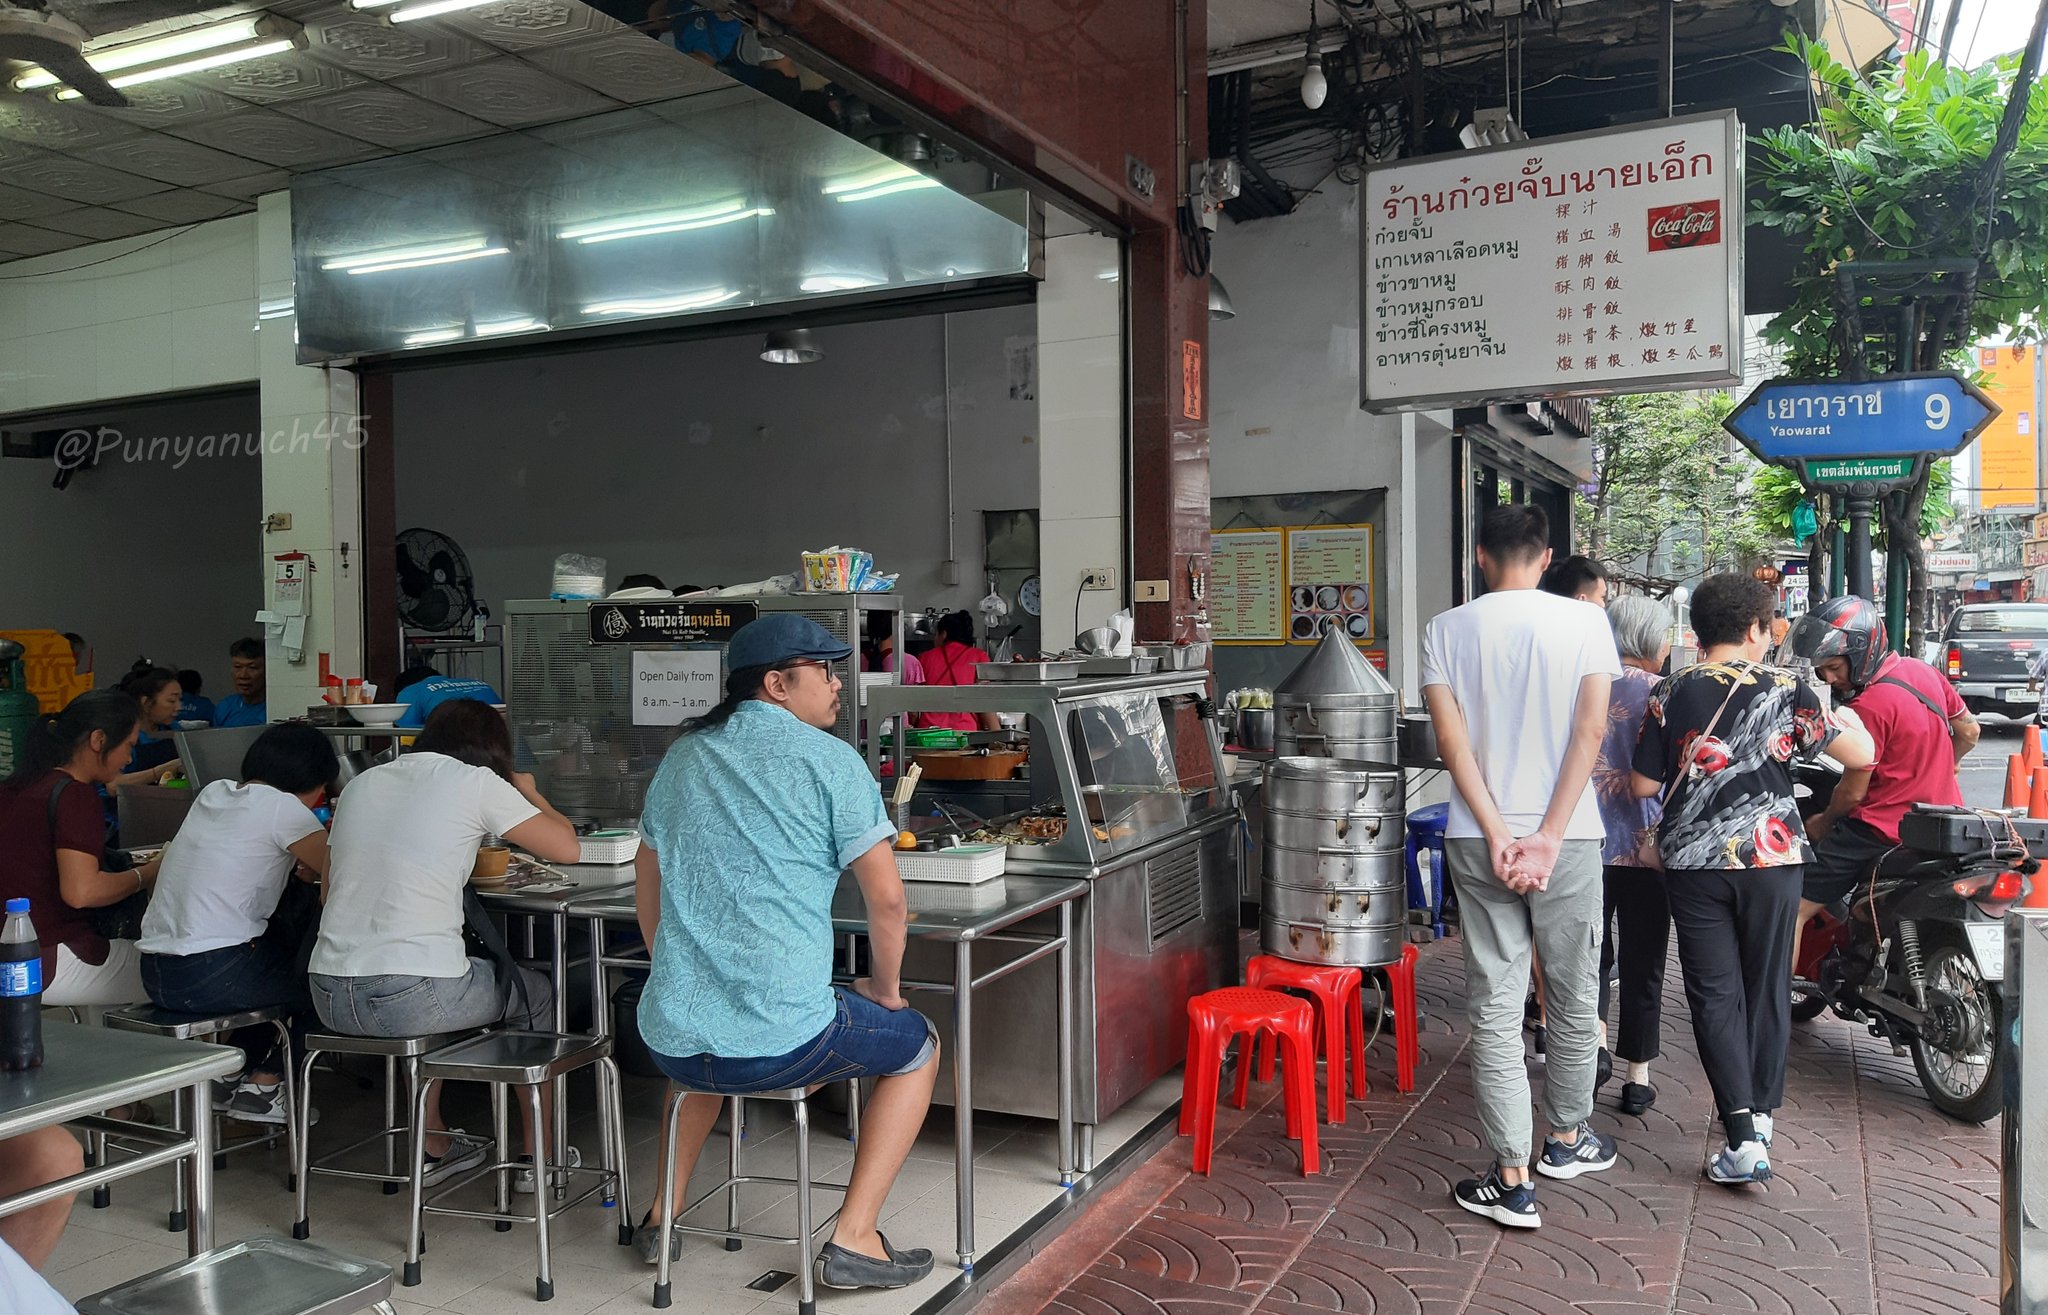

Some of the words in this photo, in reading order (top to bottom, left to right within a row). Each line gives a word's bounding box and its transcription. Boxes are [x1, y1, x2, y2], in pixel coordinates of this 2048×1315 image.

[1382, 140, 1712, 219] ร้านก๋วยจั๊บนายเอ็ก
[1375, 217, 1433, 245] ก๋วยจั๊บ
[1651, 210, 1716, 239] Coca-Cola
[1375, 239, 1519, 270] เกาเหลาเลือดหมู
[1376, 273, 1456, 294] ข้าวขาหมู
[1375, 294, 1483, 319] ข้าวหมูกรอบ
[1375, 317, 1487, 343] ข้าวซี่โครงหมู
[1376, 337, 1506, 367] อาหารตุ๋นยาจีน
[1767, 391, 1882, 420] เยาวราช
[1925, 394, 1951, 430] 9
[1770, 424, 1831, 437] Yaowarat
[1816, 460, 1902, 478] เขตสัมพันธวงศ์
[285, 564, 294, 579] 5
[640, 671, 664, 683] Open
[666, 671, 689, 683] Daily
[691, 670, 714, 681] from
[642, 696, 649, 707] 8
[650, 698, 671, 707] a.m.
[681, 697, 687, 707] 1
[689, 698, 710, 707] a.m.
